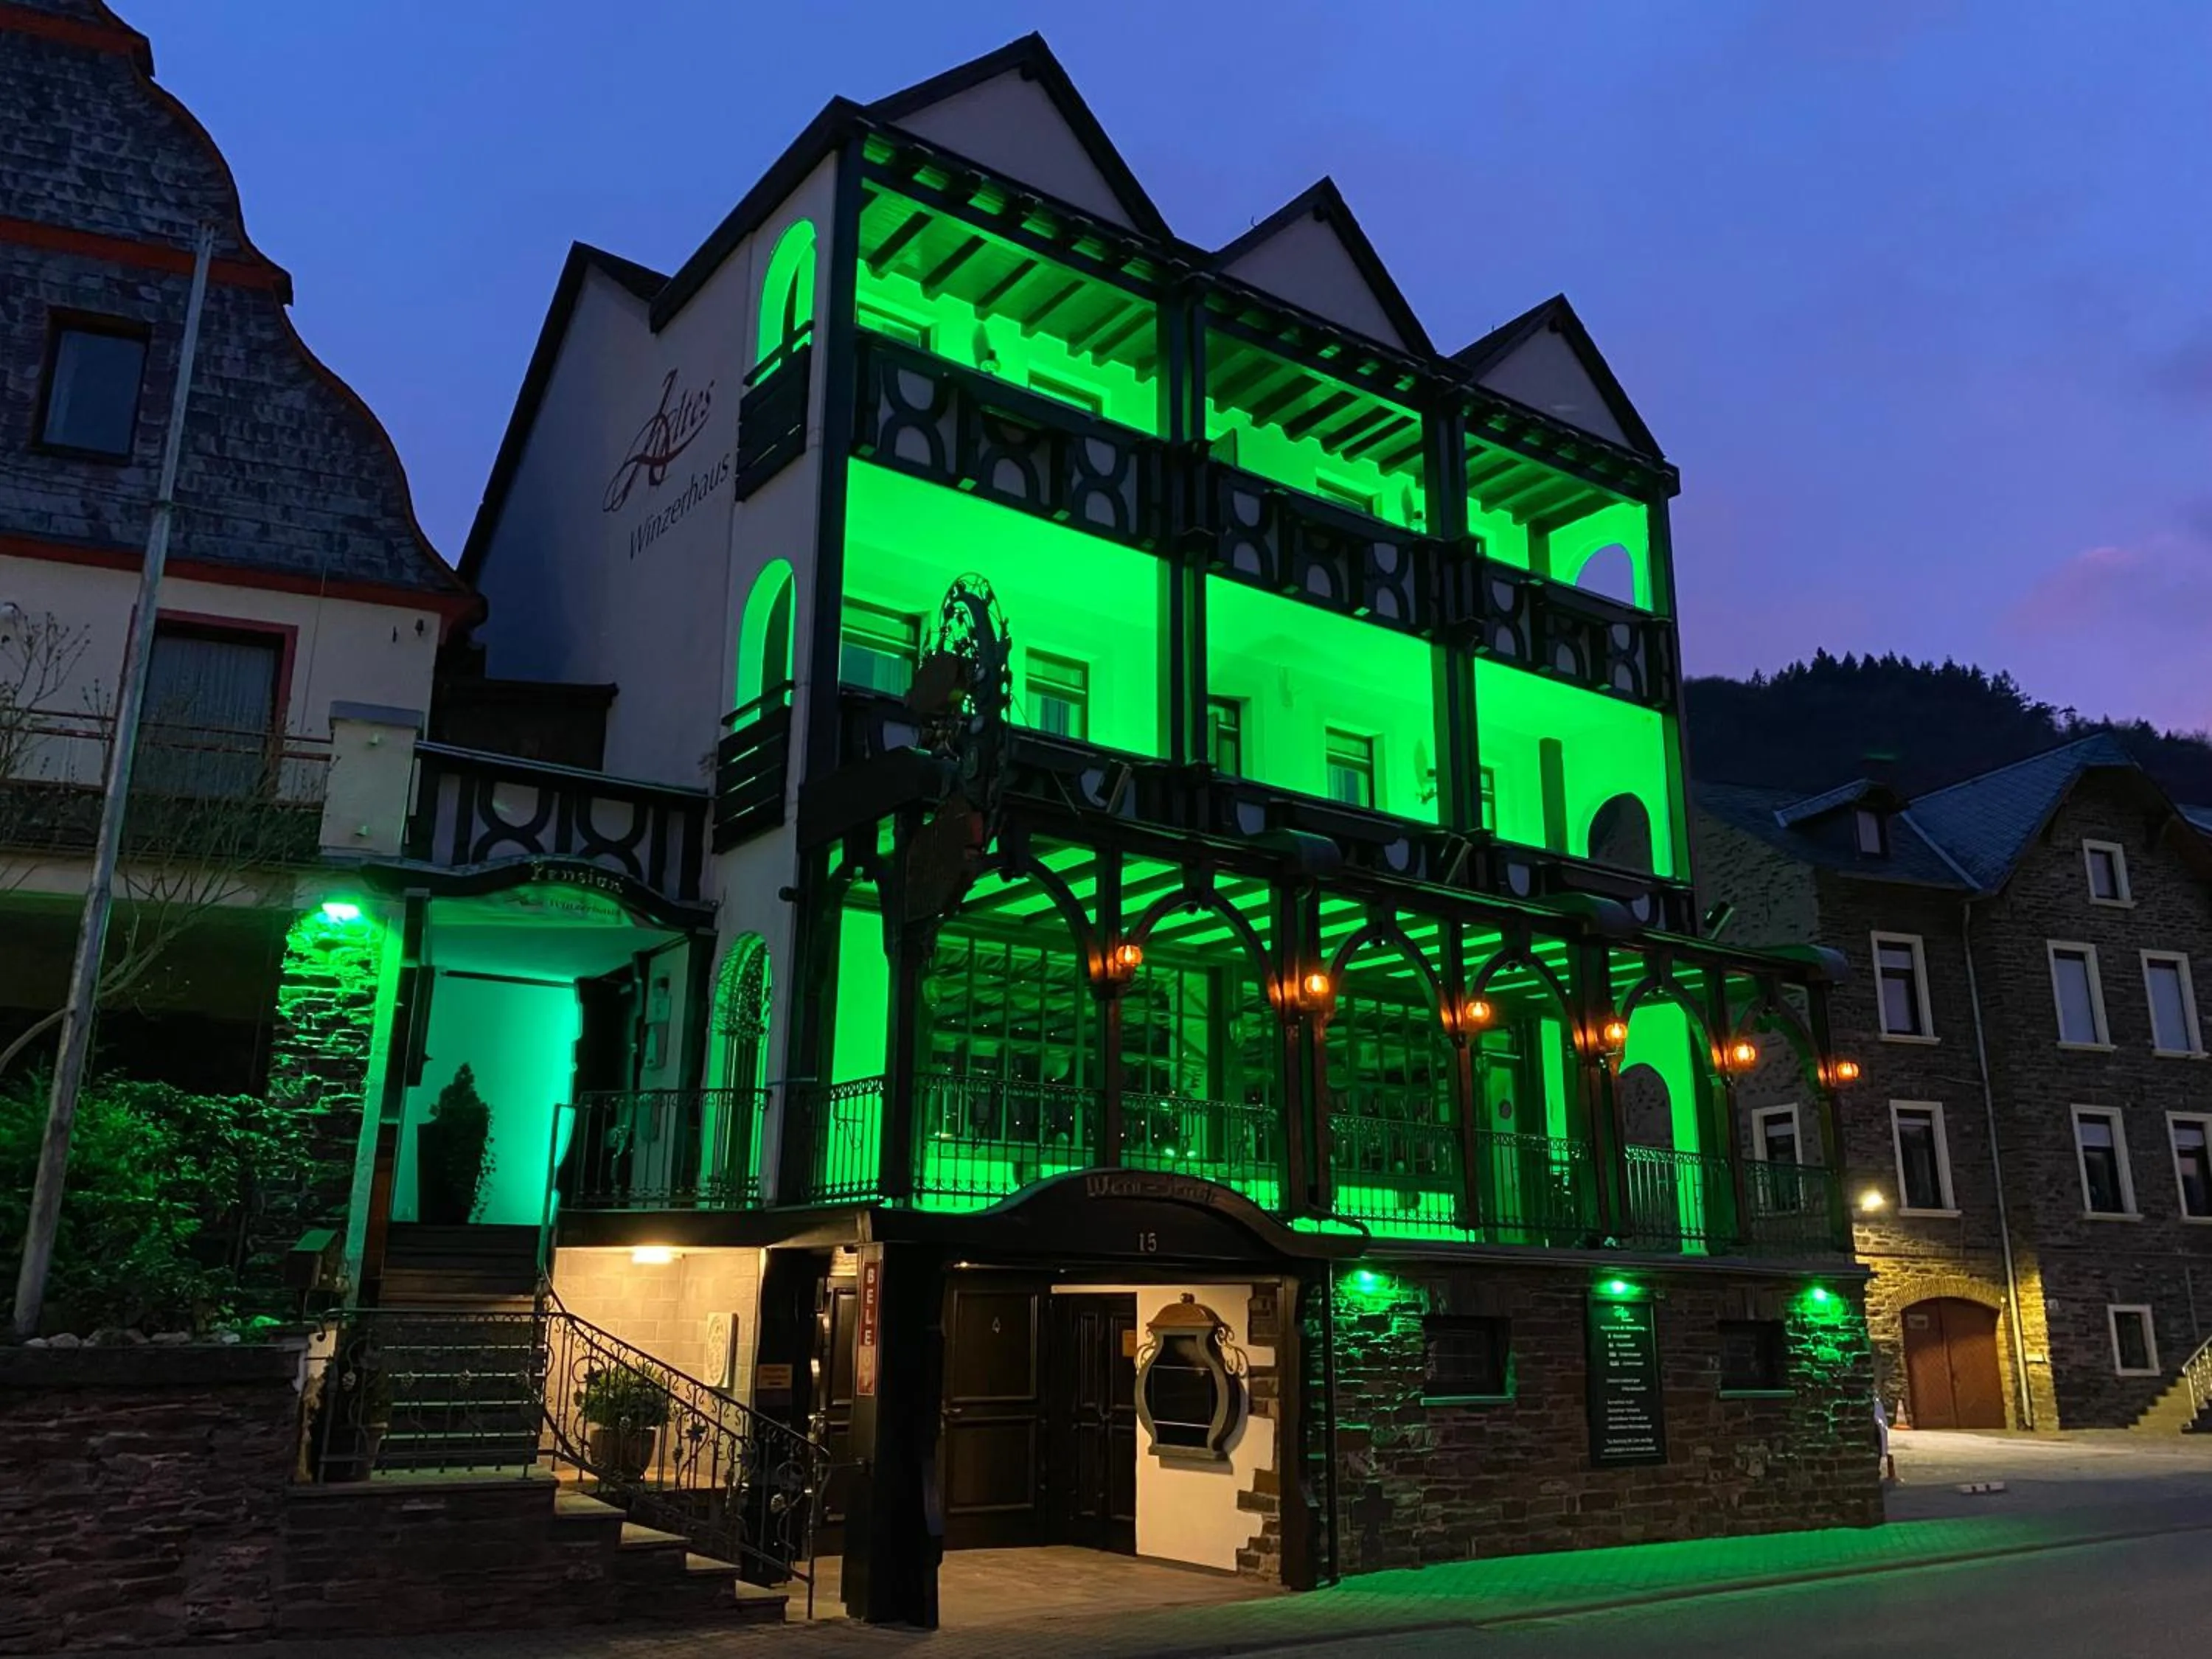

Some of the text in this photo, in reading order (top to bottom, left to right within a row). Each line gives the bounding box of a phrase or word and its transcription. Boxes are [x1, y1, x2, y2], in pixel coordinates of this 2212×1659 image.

[630, 452, 730, 561] Winzerhaus
[530, 860, 624, 894] Pension
[1138, 1232, 1158, 1252] 15
